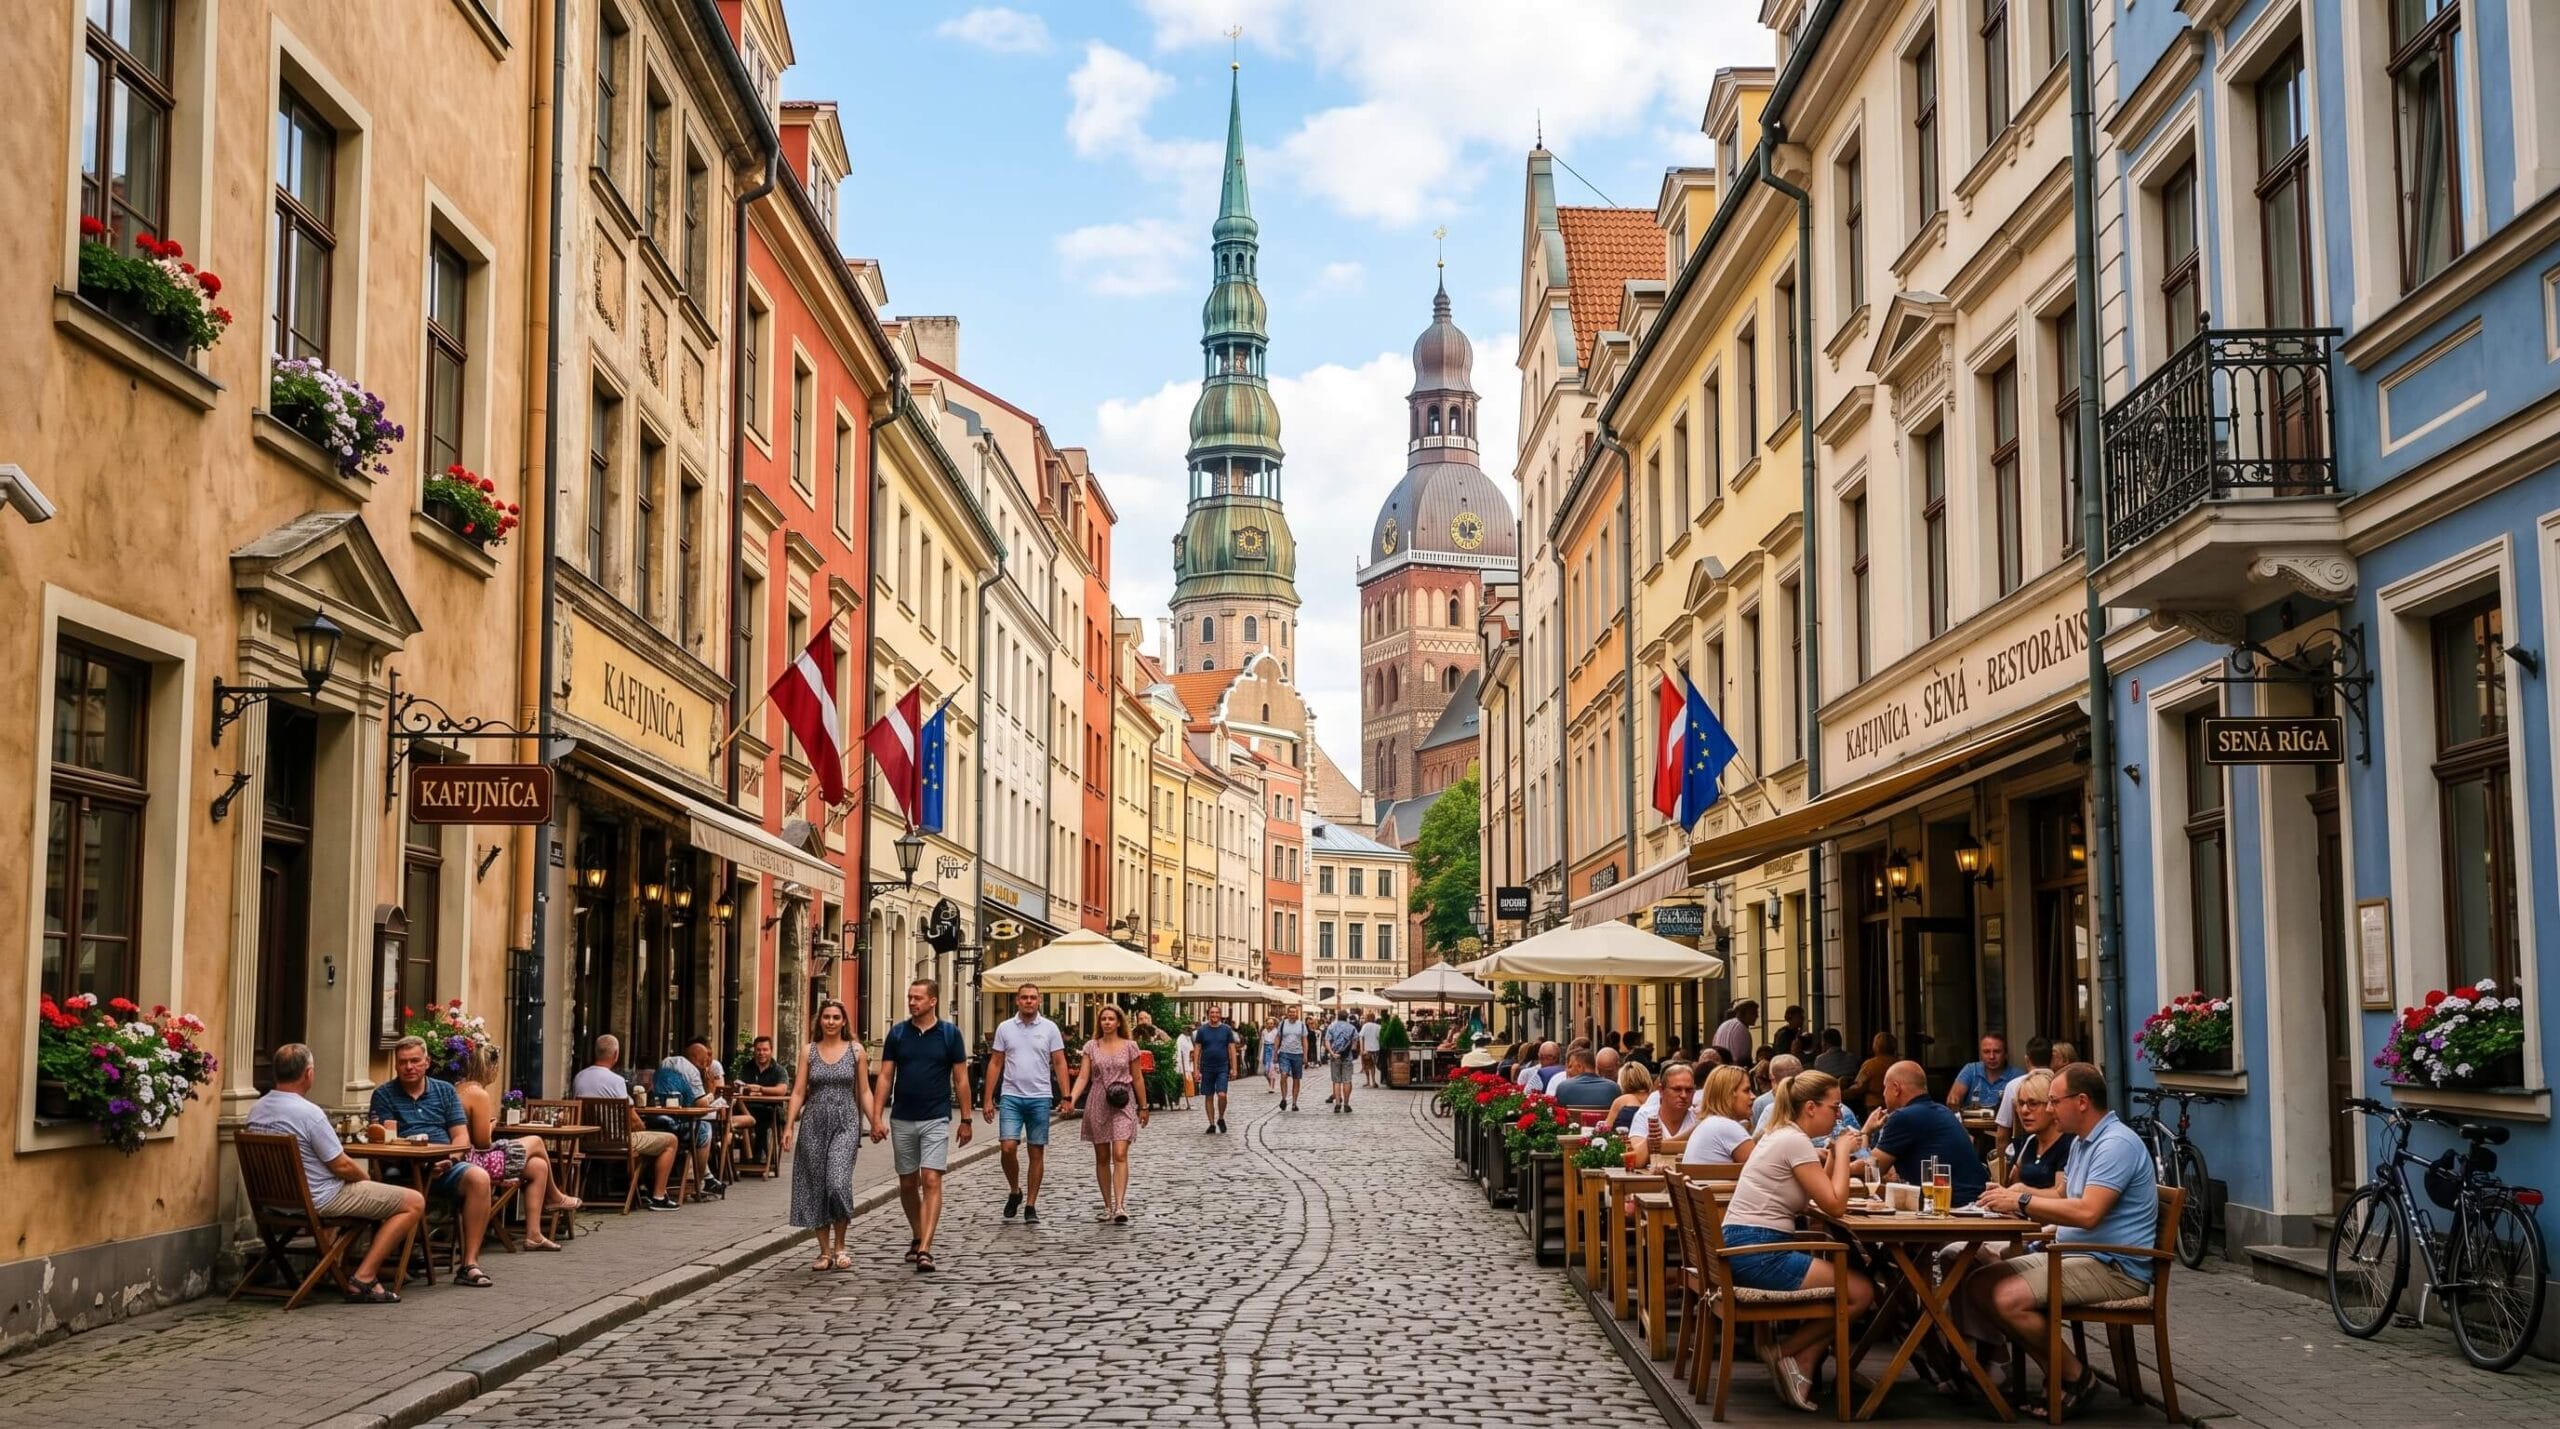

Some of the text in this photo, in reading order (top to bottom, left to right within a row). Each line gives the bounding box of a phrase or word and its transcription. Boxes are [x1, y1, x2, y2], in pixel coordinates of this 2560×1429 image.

[2218, 726, 2330, 752] SENĀ RĪGA
[420, 776, 540, 814] KAFIJNĪCA
